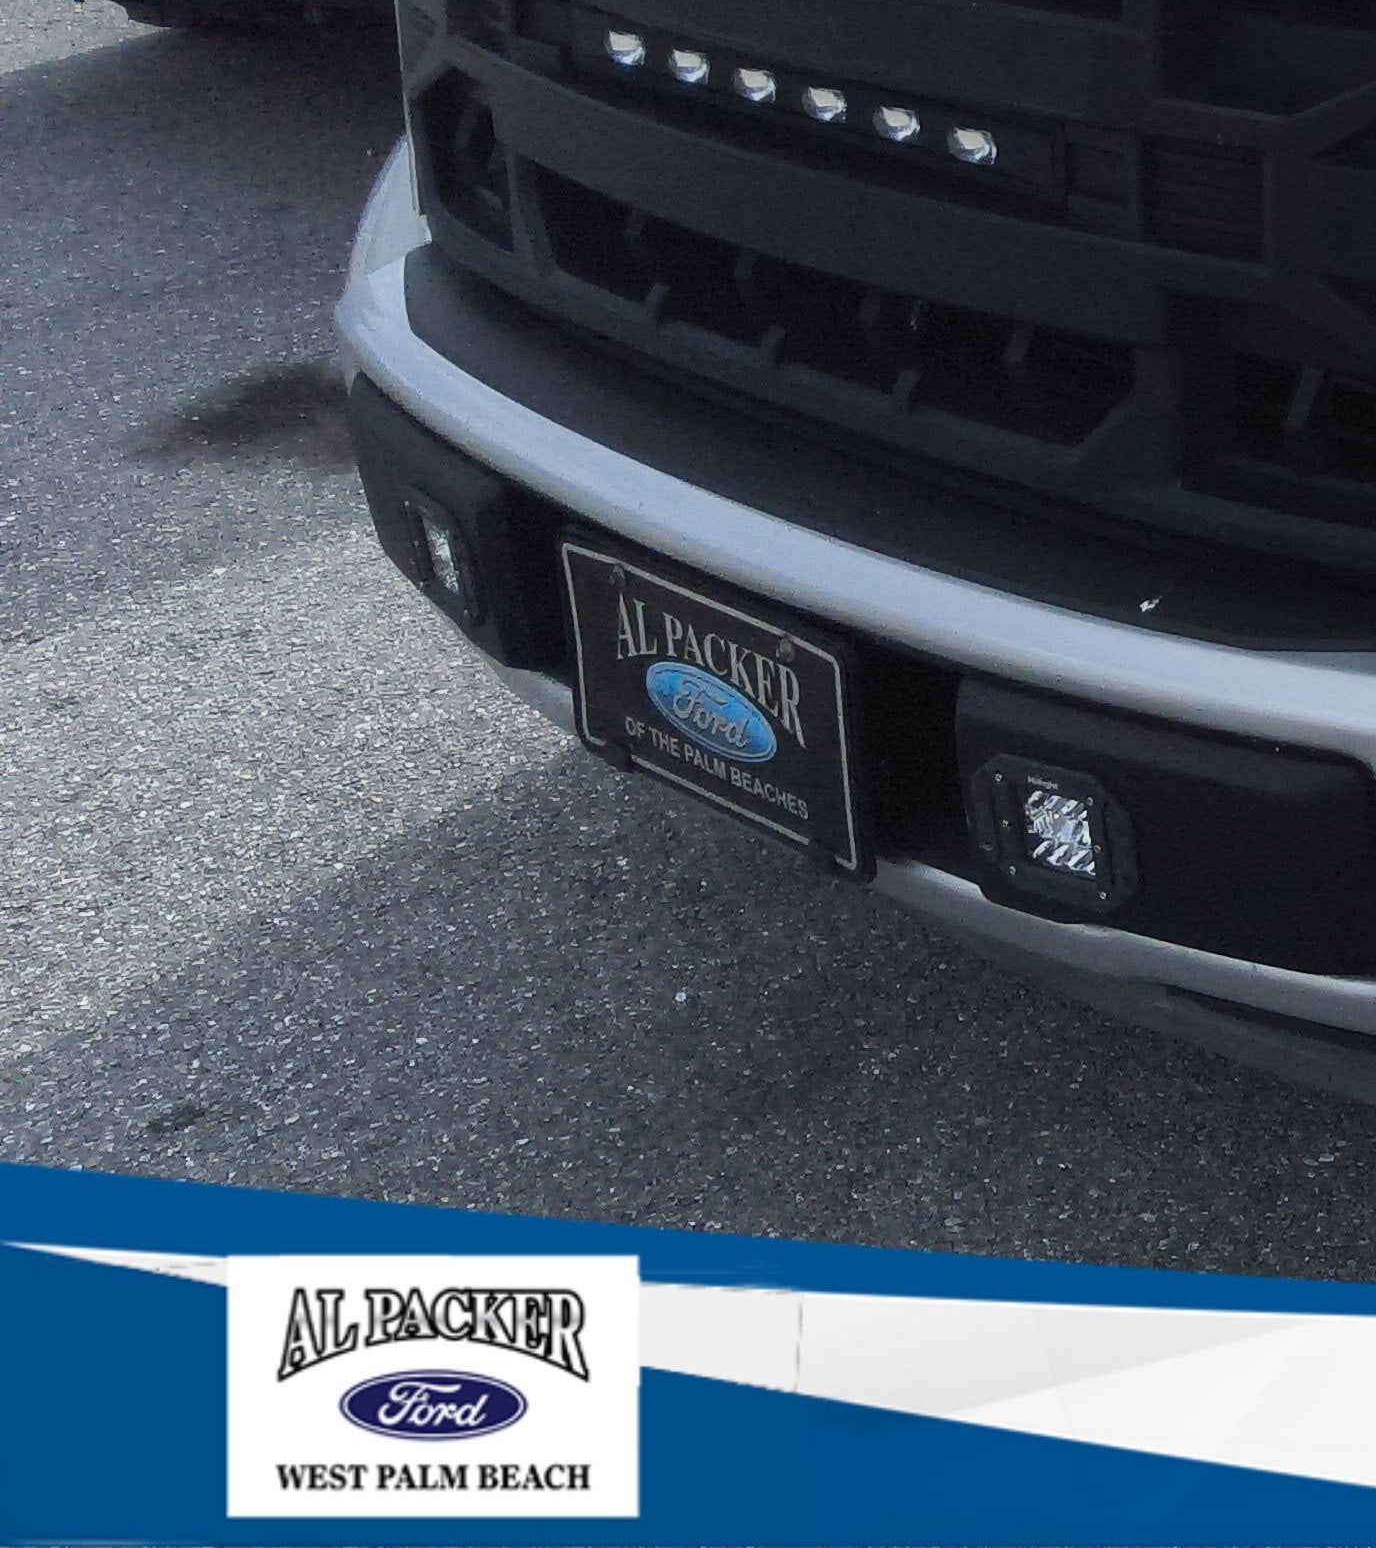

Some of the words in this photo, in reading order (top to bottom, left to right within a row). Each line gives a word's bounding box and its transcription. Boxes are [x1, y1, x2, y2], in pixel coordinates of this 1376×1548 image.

[617, 592, 657, 660] AL
[662, 612, 807, 750] PACKER
[673, 679, 749, 748] Ford
[625, 715, 645, 738] OF
[650, 727, 681, 758] THE
[684, 743, 728, 780] PALM
[730, 766, 809, 820] BEACHES
